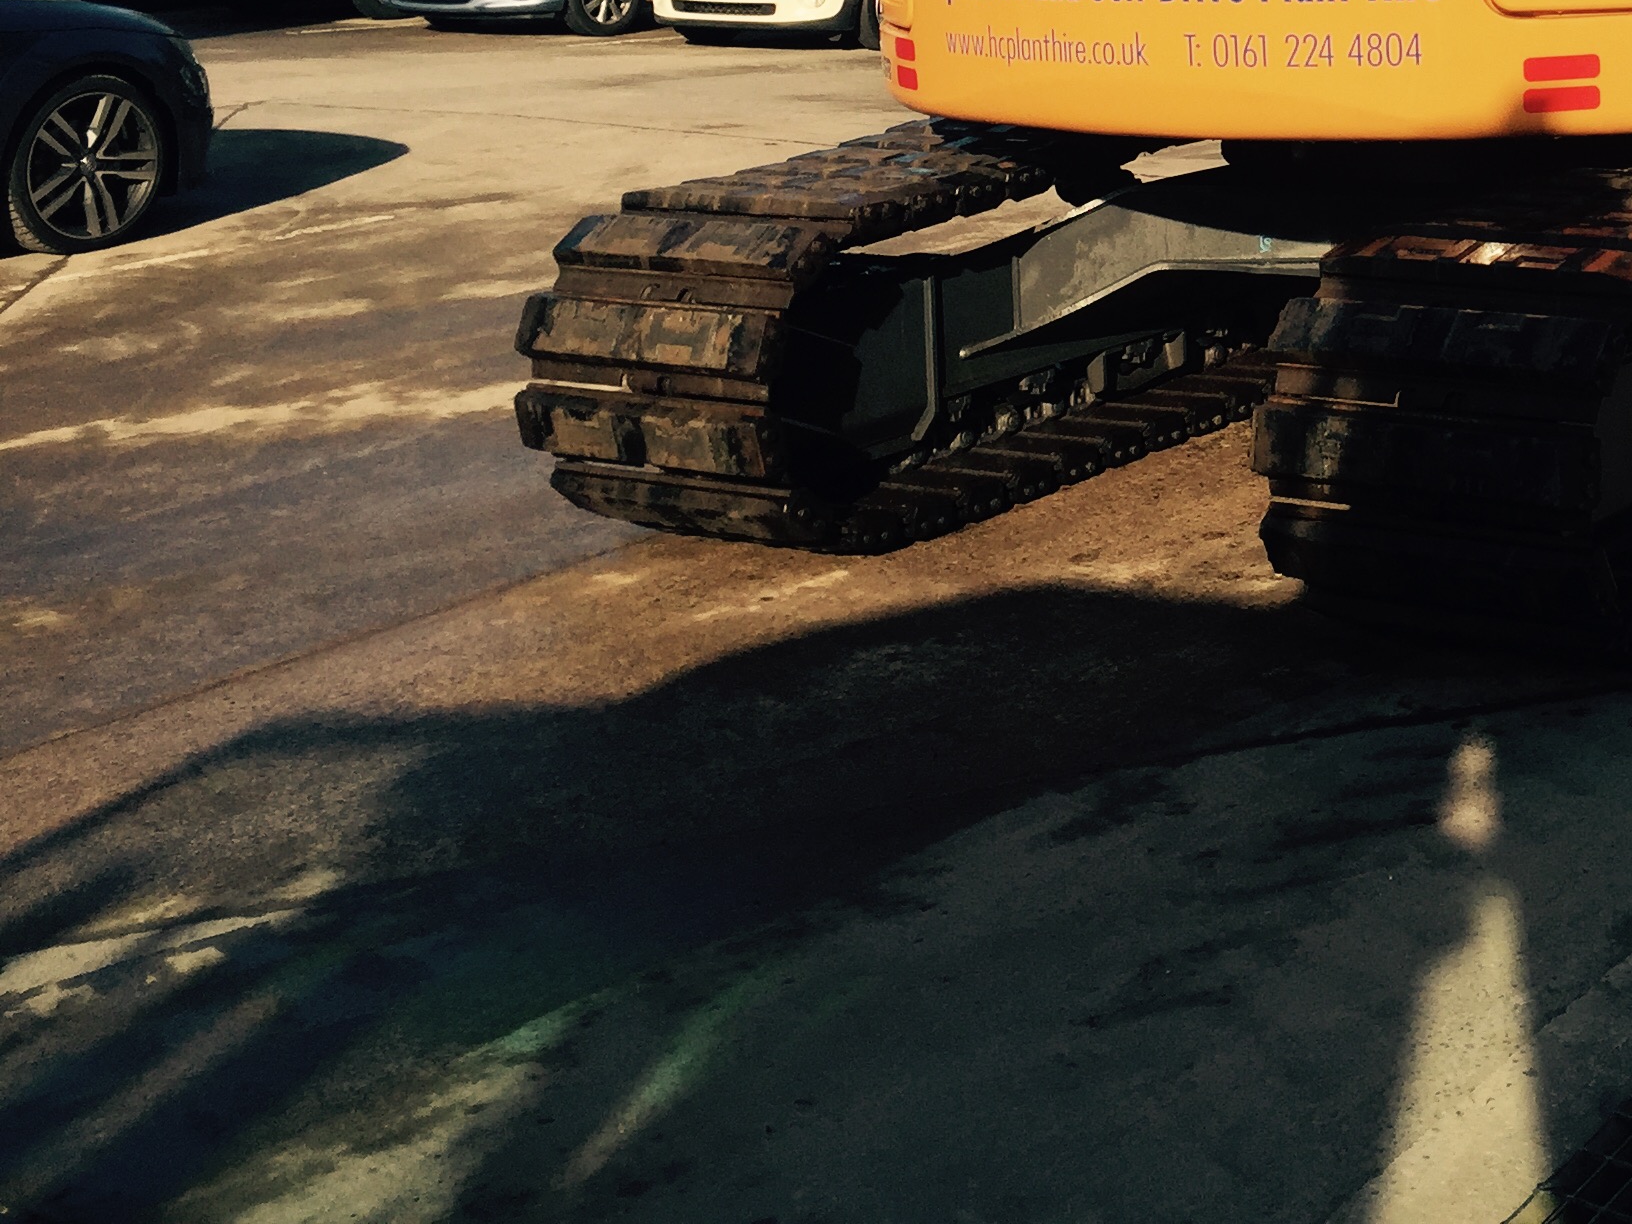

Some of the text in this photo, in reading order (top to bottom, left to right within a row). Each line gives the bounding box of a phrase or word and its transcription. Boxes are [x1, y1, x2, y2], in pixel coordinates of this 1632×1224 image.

[945, 25, 1423, 68] www.hcplanthire.co.uk T: 0161 224 4804
